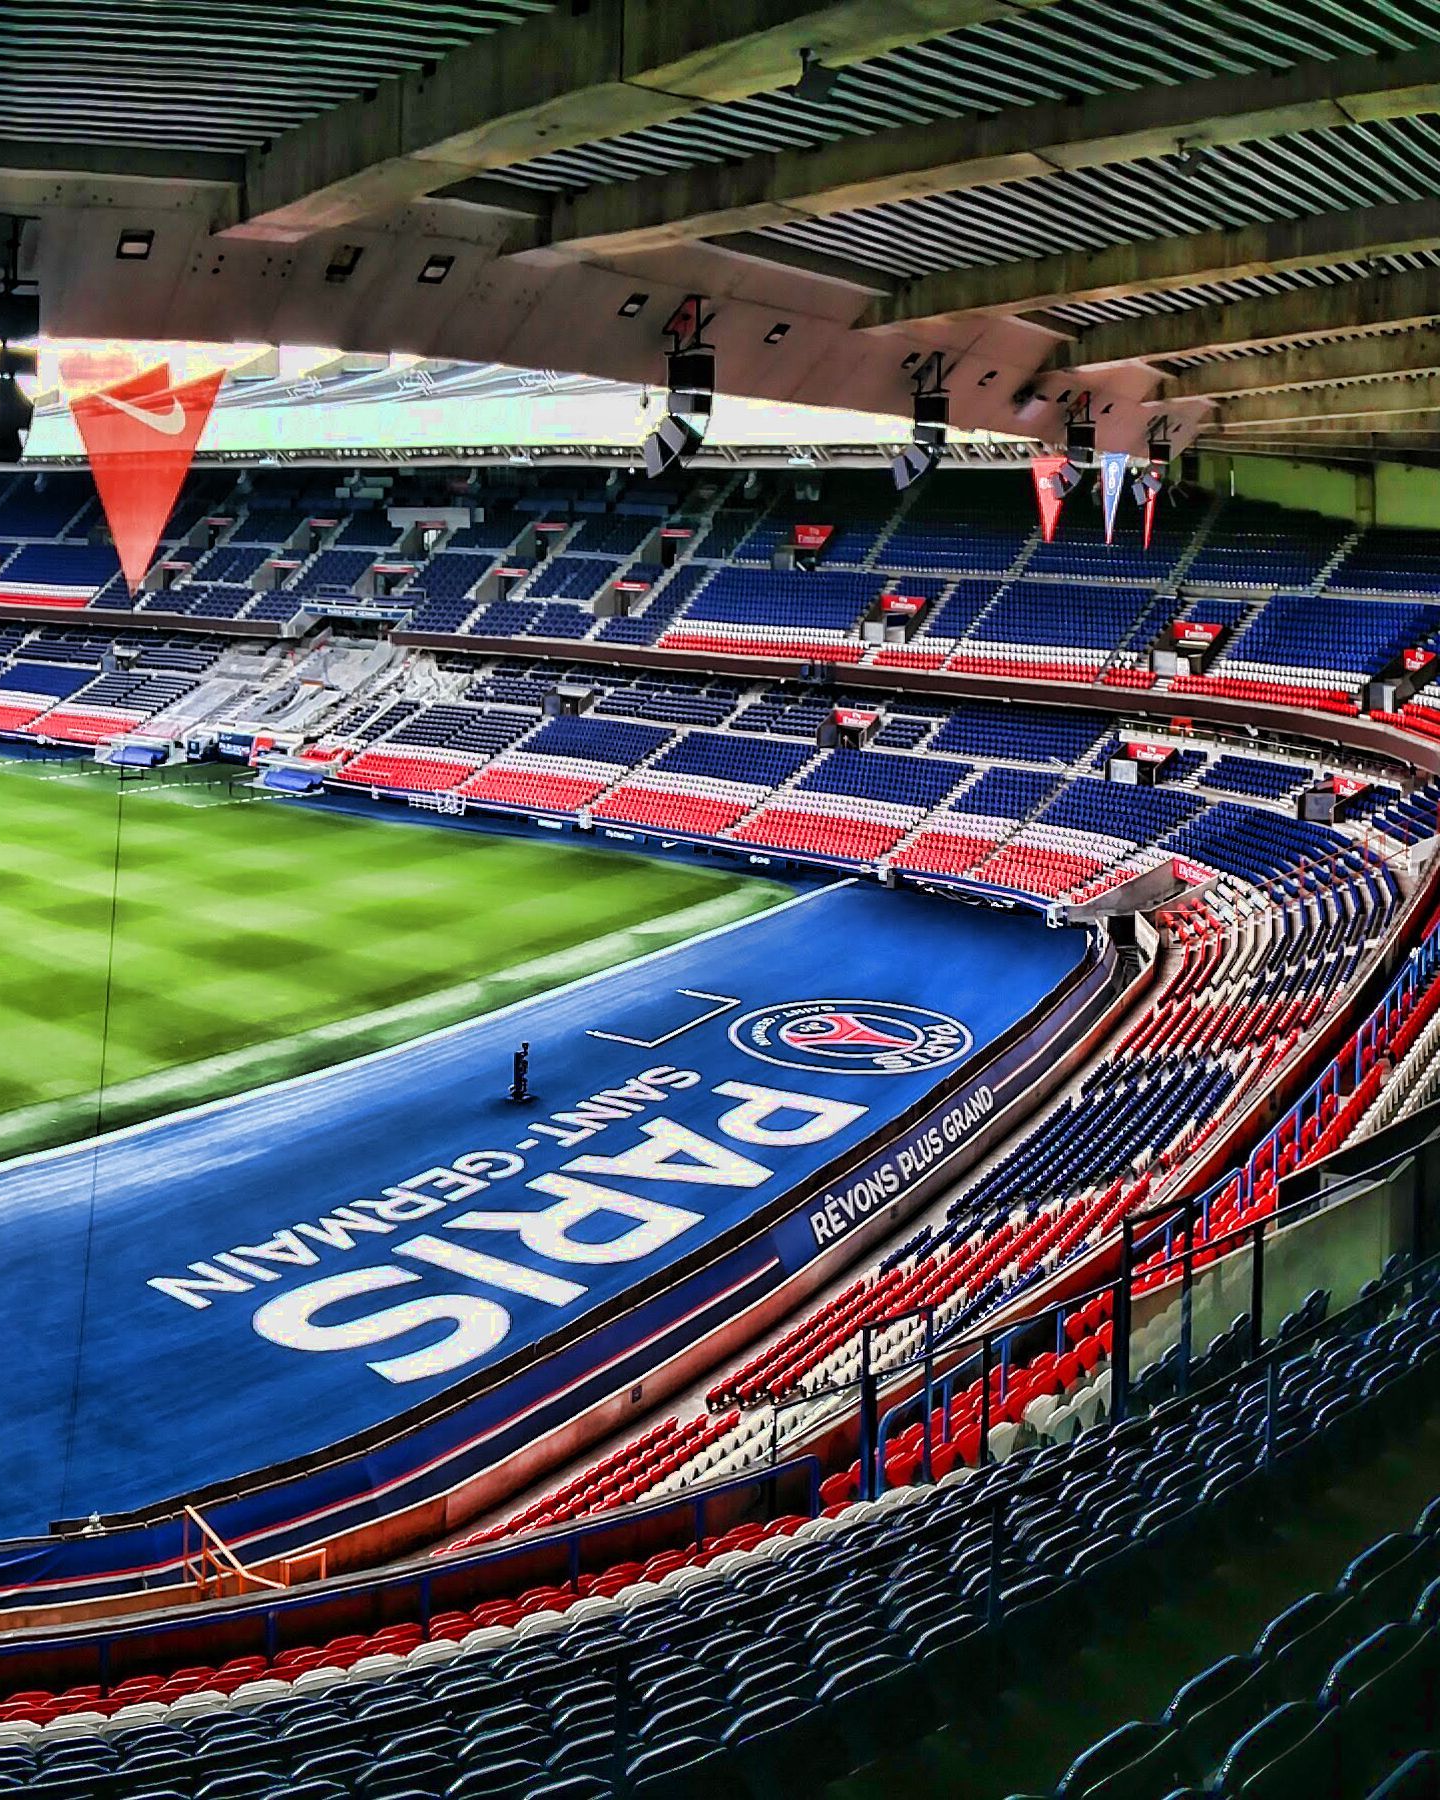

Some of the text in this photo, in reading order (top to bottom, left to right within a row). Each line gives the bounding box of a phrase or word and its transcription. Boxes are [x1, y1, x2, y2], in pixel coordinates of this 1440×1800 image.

[872, 1023, 961, 1070] PARIS
[253, 1080, 870, 1384] PARIS
[810, 1085, 994, 1245] RÊVONS PLUS GRAND
